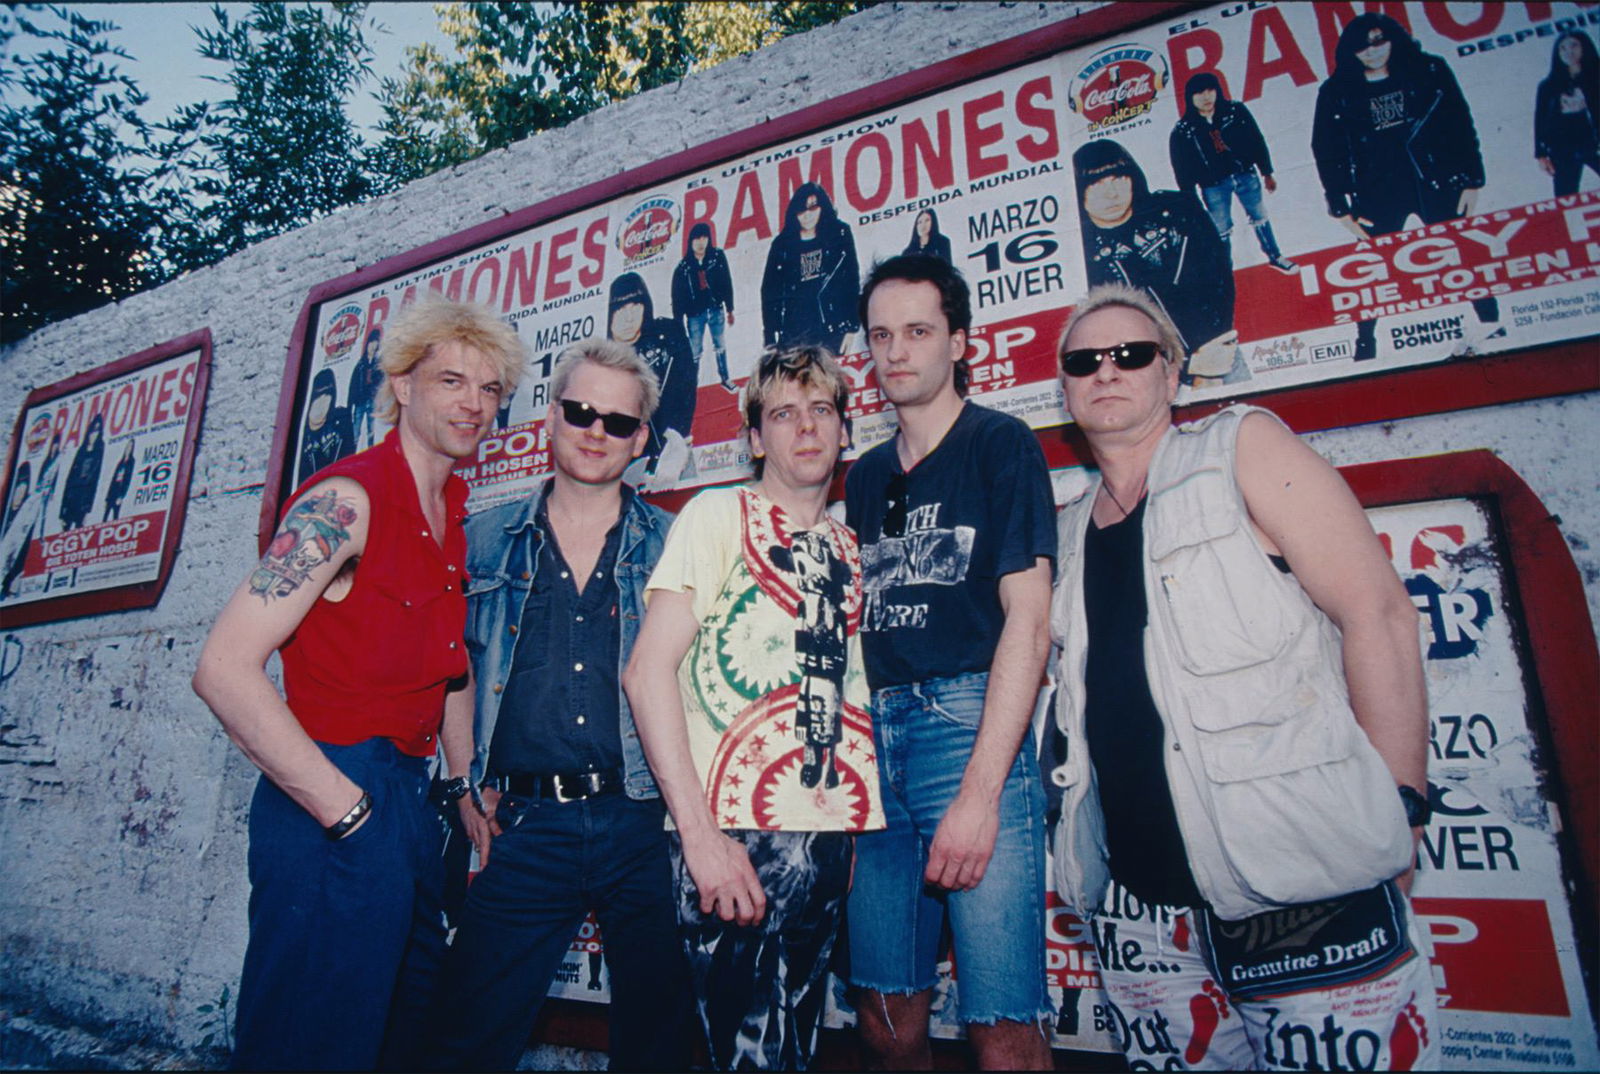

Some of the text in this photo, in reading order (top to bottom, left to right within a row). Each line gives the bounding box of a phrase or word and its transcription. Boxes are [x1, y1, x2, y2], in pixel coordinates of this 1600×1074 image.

[1168, 19, 1209, 36] EL
[1089, 118, 1152, 139] PRESENTA
[1101, 98, 1158, 128] CONCERT
[681, 75, 1060, 257] RAMONES
[687, 115, 898, 189] EL ULTIMO SHOW
[858, 161, 1064, 226] DESPEDIDA MUNDIAL
[968, 195, 1059, 243] MARZO
[1355, 211, 1512, 251] ARTISTAS
[371, 243, 511, 299] EL ULTIMO SHOW
[967, 230, 1059, 273] 16
[1300, 218, 1528, 296] IGGY
[542, 287, 604, 312] MUNDIAL
[977, 263, 1064, 309] RIVER
[1331, 248, 1571, 311] DIE TOTEN
[1334, 313, 1353, 325] 2
[1360, 282, 1513, 320] MINUTOS
[535, 315, 595, 353] MARZO
[1390, 314, 1465, 338] DUNKIN'
[1393, 328, 1464, 350] DONUTS
[1266, 353, 1294, 367] 106.3
[1314, 344, 1348, 360] EMI
[51, 362, 197, 449] RAMONES
[143, 440, 178, 464] MARZO
[482, 452, 549, 476] HOSEN
[138, 461, 172, 486] 16
[134, 483, 169, 505] RIVER
[41, 529, 95, 558] IGGY
[98, 519, 150, 546] POP
[1091, 917, 1181, 973] Me...
[1231, 952, 1320, 982] Genuine
[1323, 927, 1389, 966] Draft
[1262, 1007, 1381, 1072] Into
